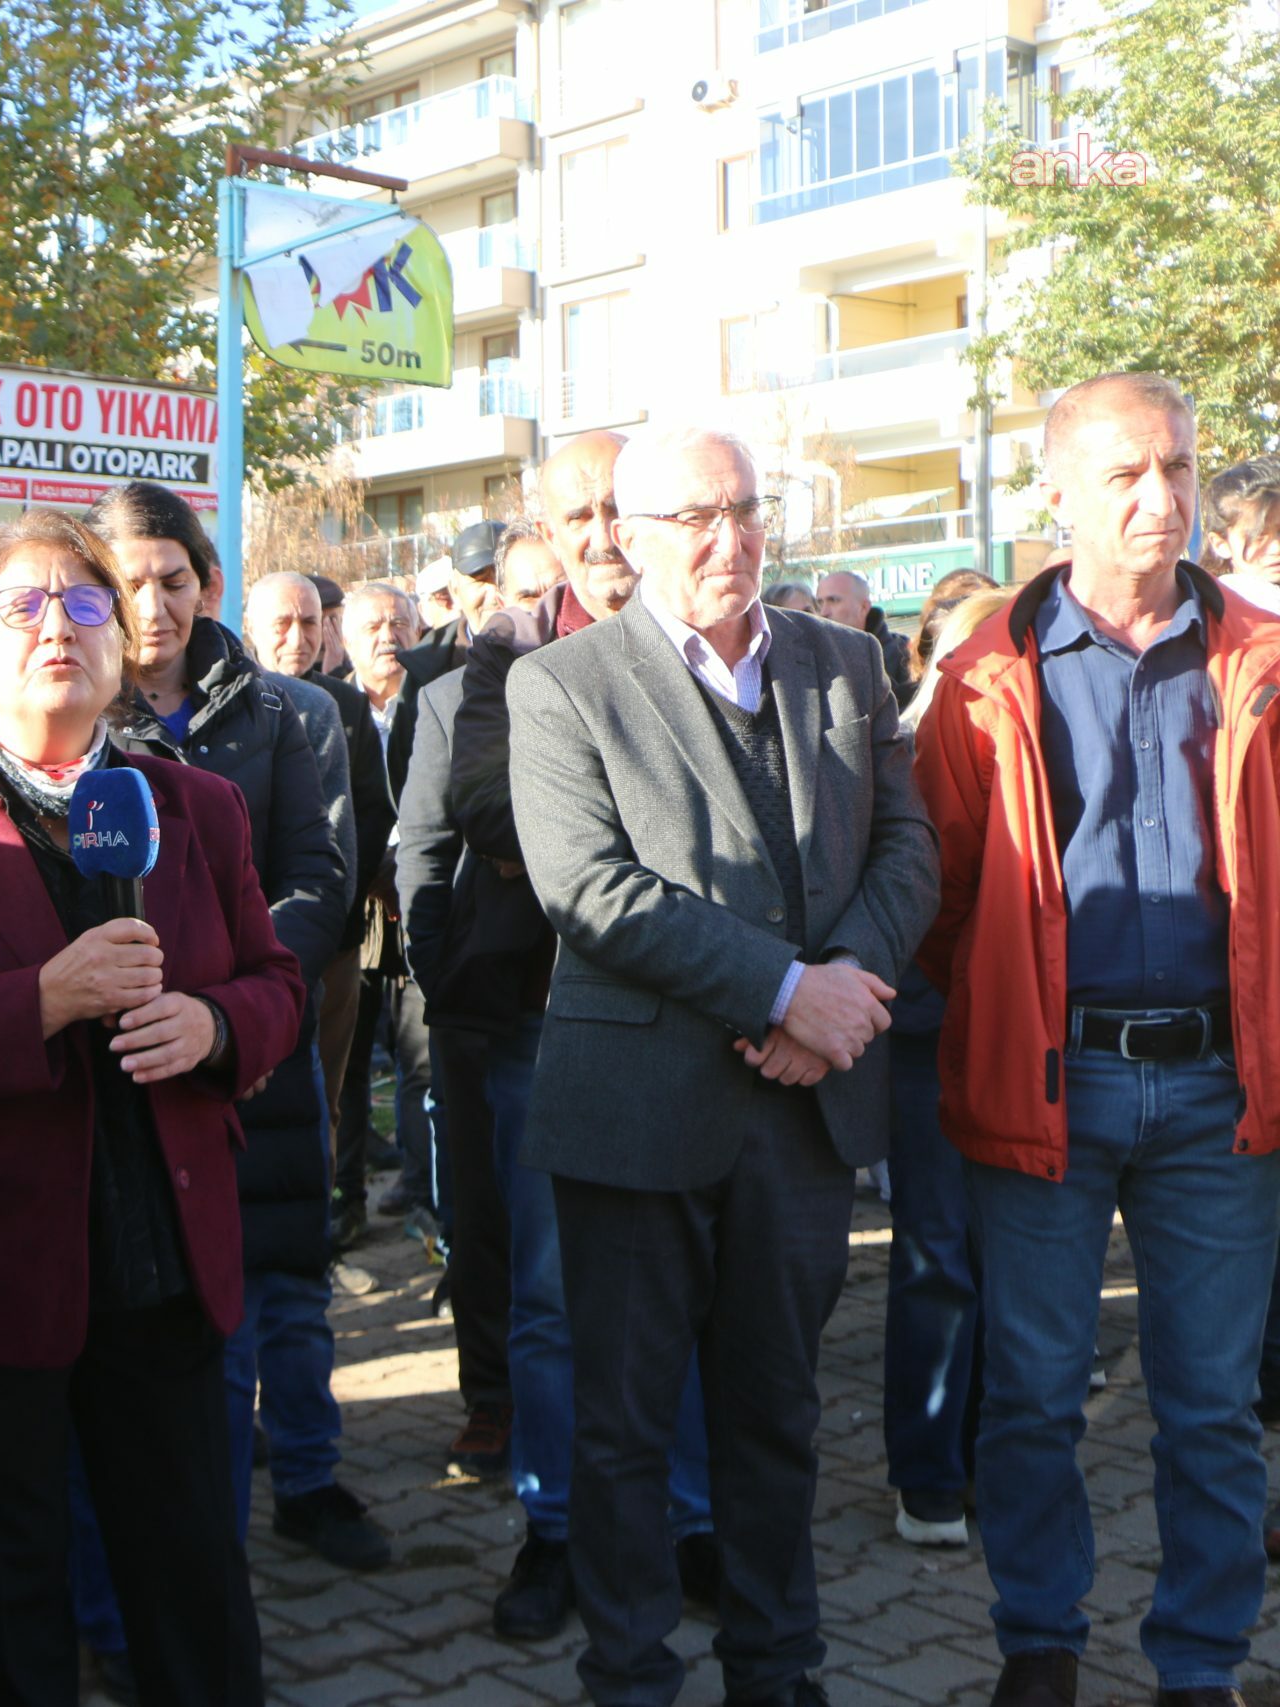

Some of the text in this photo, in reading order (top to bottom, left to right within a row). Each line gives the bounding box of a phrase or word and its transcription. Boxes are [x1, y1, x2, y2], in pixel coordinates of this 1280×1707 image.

[360, 339, 423, 369] 50m
[16, 382, 83, 431] OTO
[70, 445, 197, 481] OTOPARK
